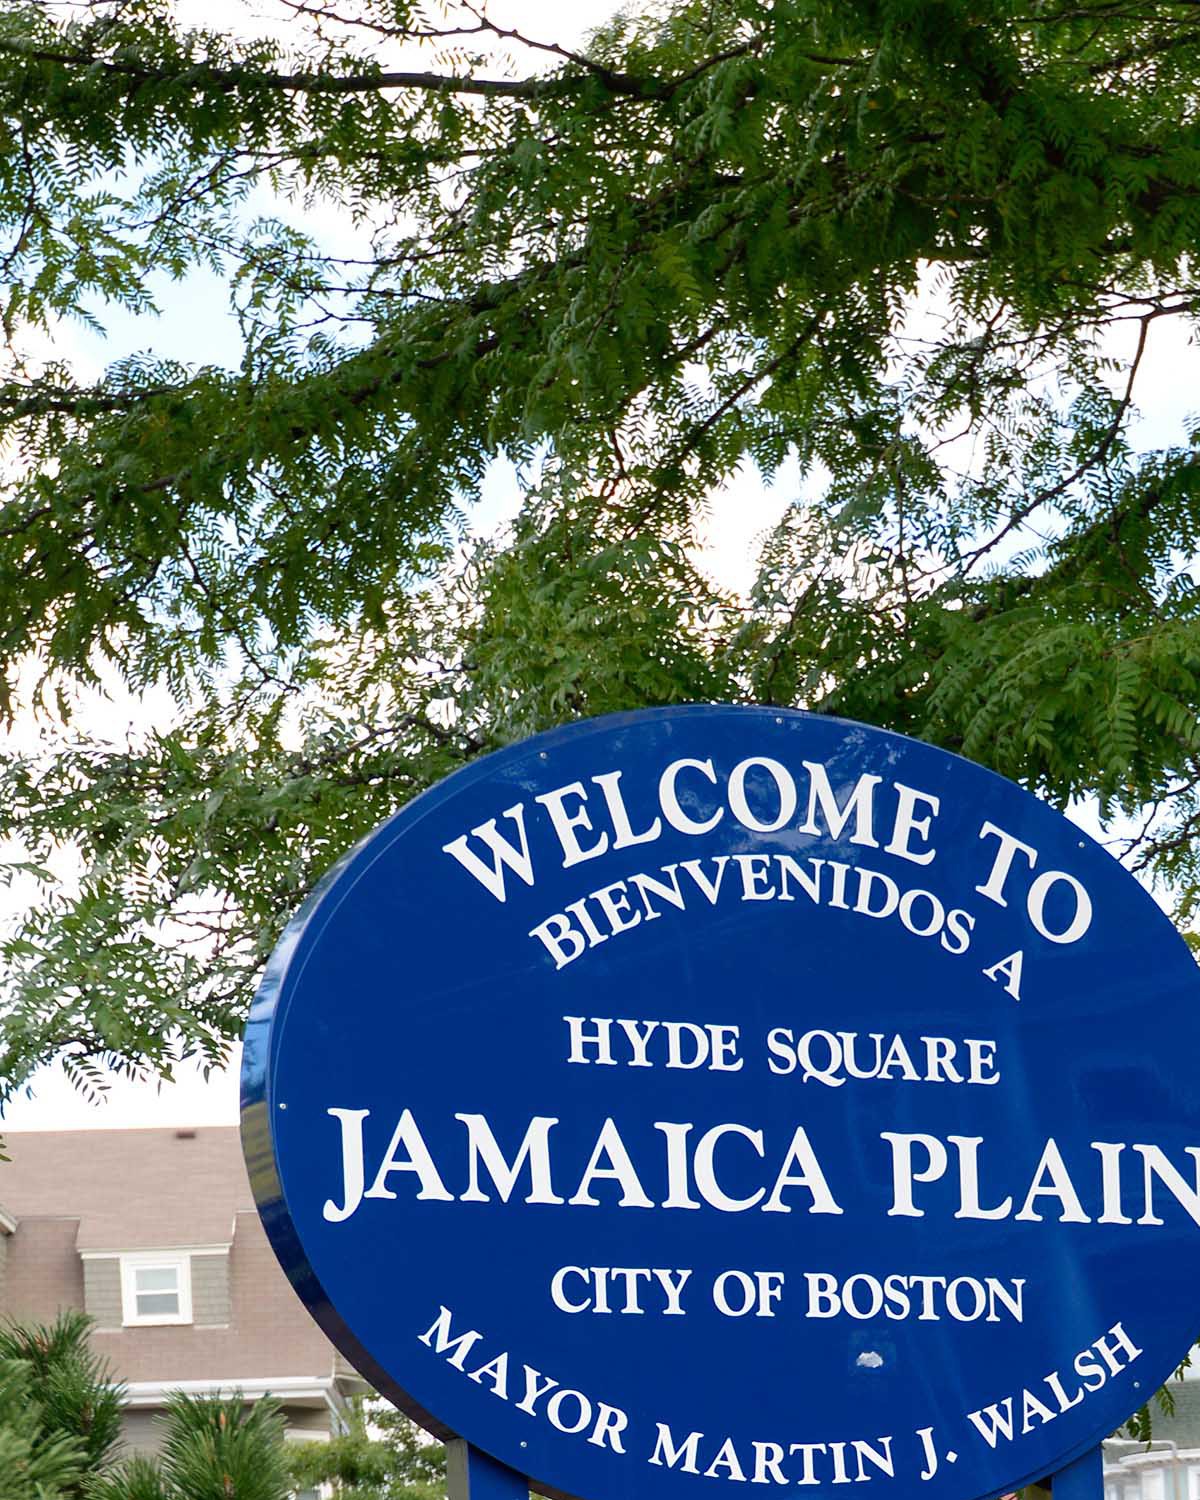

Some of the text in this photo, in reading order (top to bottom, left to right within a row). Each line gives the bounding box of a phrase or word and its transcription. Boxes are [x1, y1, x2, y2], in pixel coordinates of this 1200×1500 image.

[442, 756, 1093, 944] WELCOME TO
[528, 854, 1023, 1001] BIENVENIDOS A
[563, 1016, 1001, 1087] HYDE SQUARE
[323, 1107, 844, 1223] JAMAICA
[551, 1265, 1026, 1323] CITY OF BOSTON
[417, 1305, 1143, 1485] MAYOR MARTIN J. WALSH
